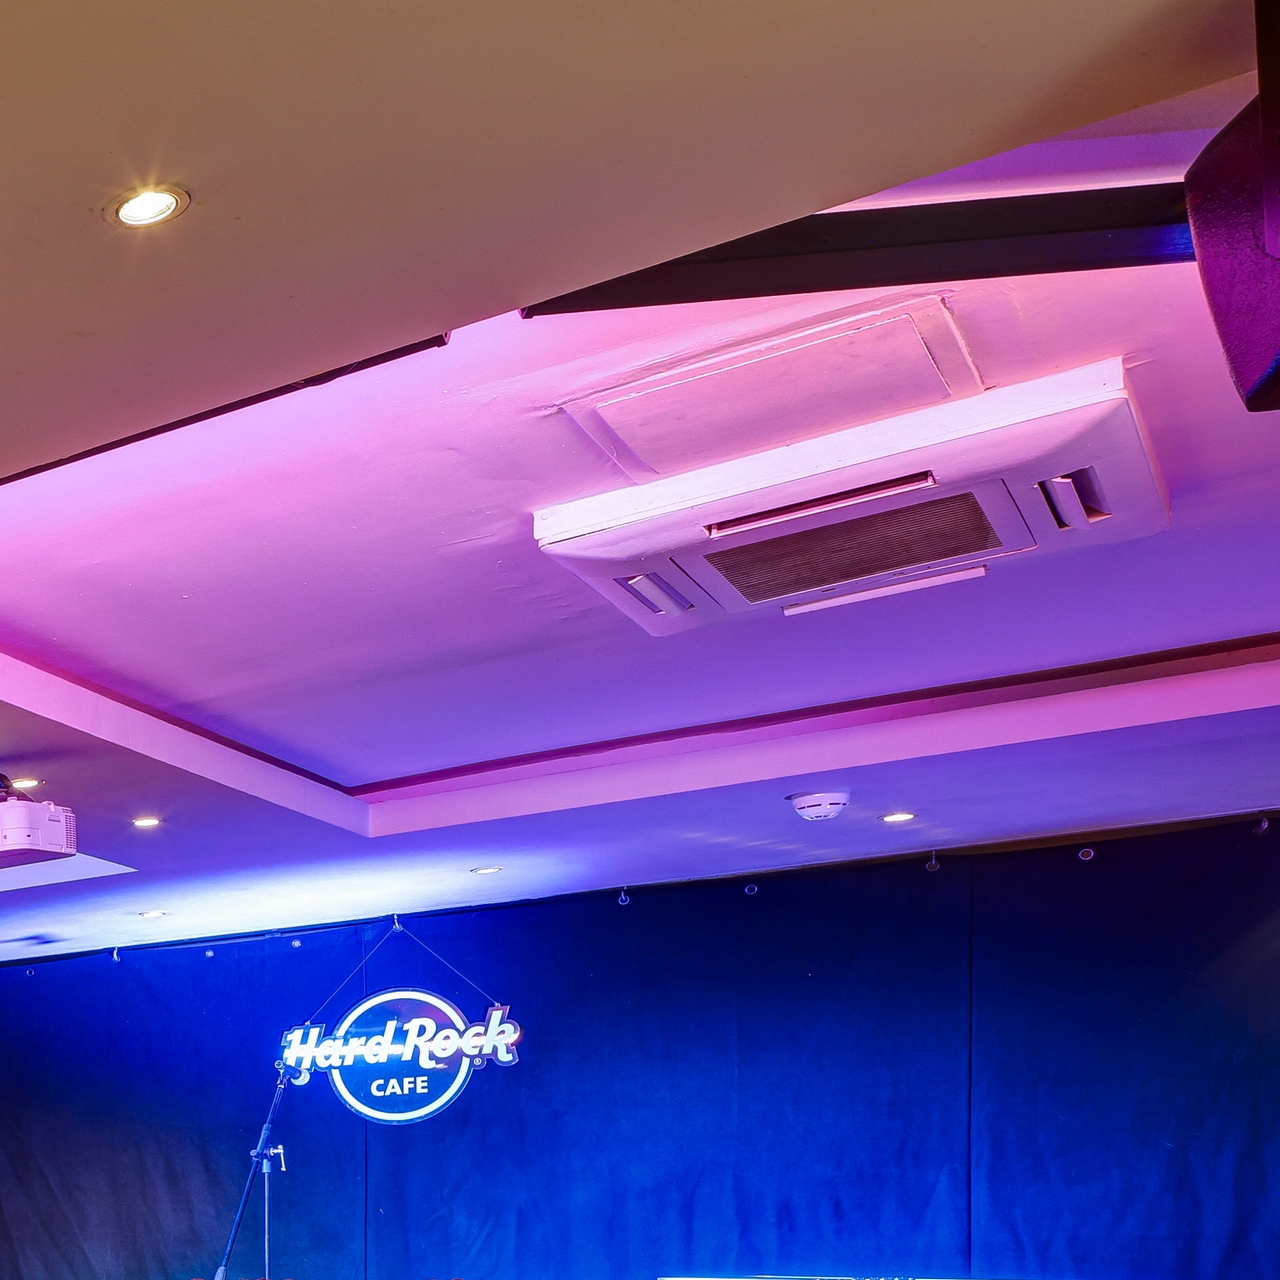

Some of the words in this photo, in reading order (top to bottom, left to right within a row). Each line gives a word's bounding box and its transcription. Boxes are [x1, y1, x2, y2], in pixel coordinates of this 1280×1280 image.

[283, 1020, 398, 1069] Hard
[401, 1010, 521, 1069] Rock
[371, 1076, 429, 1097] CAFE
